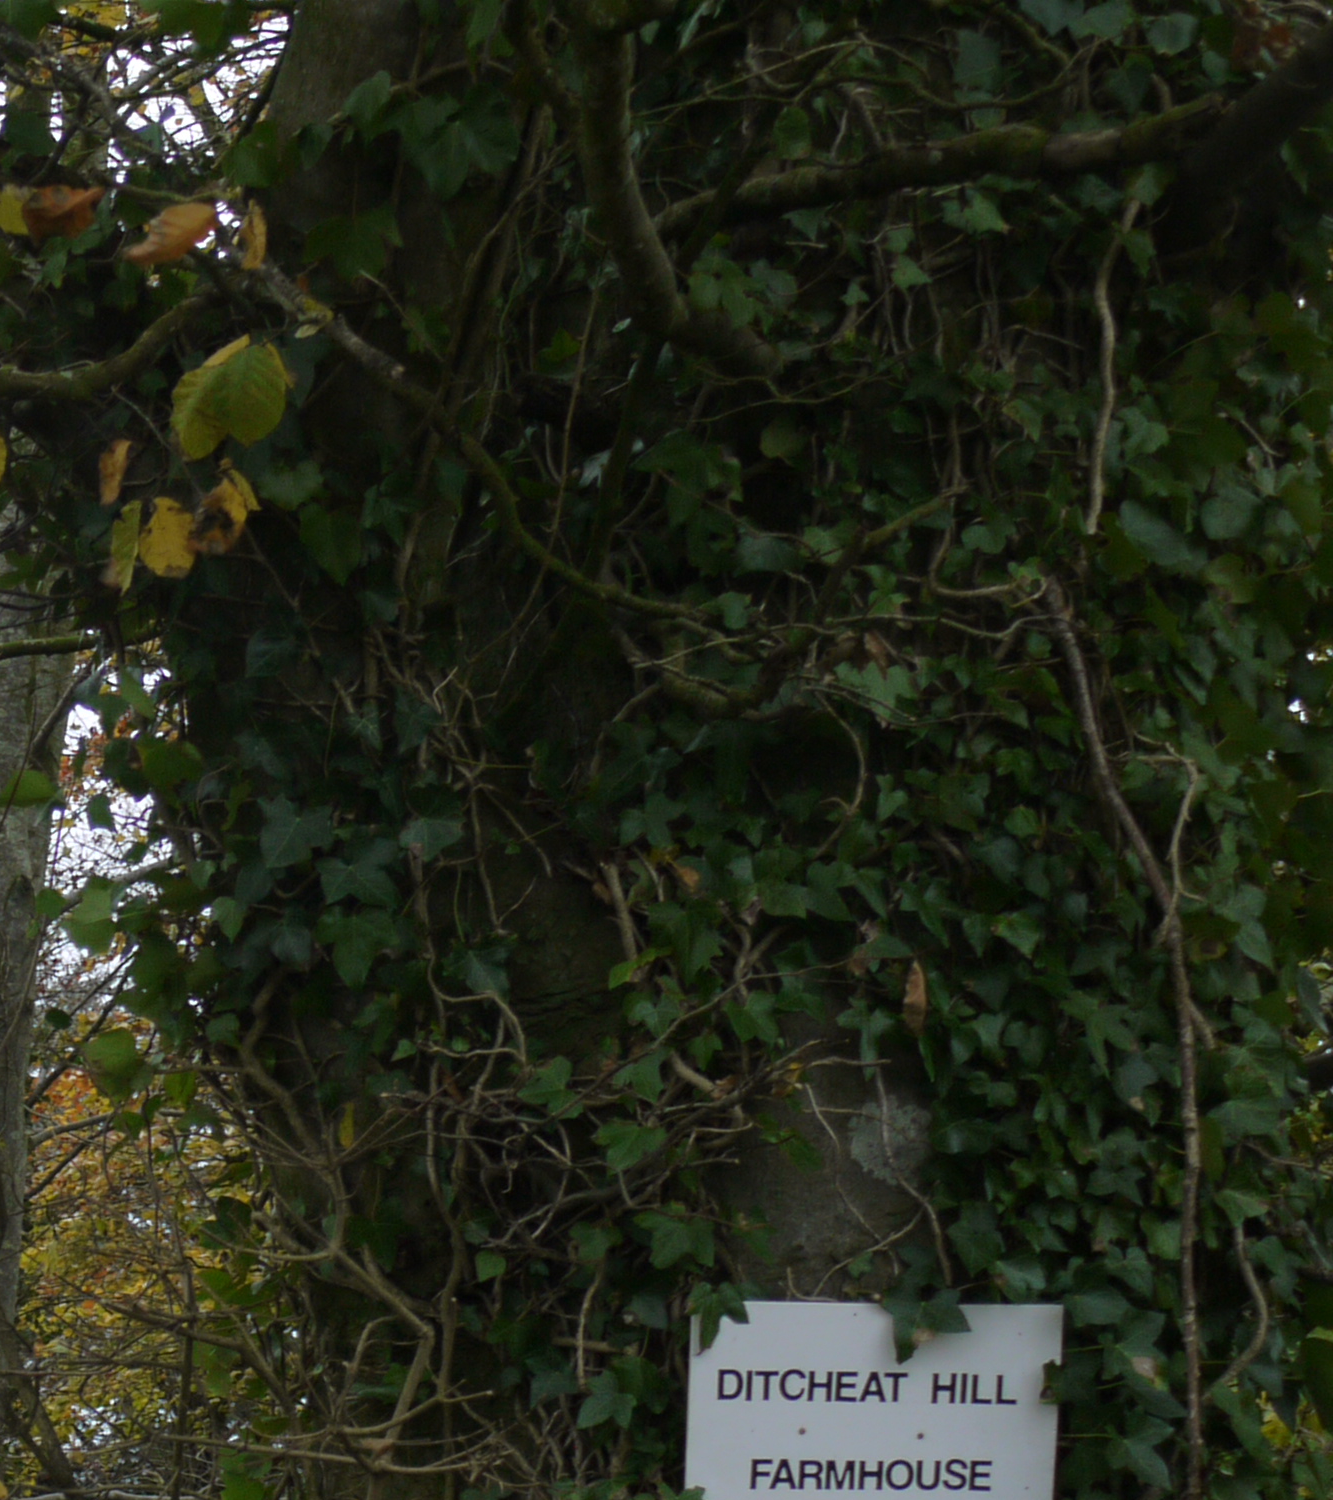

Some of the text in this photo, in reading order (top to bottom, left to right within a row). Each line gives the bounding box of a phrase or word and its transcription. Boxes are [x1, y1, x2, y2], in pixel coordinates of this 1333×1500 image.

[717, 1369, 1018, 1405] DITCHEAT HILL
[749, 1458, 993, 1491] FARMHOUSE
